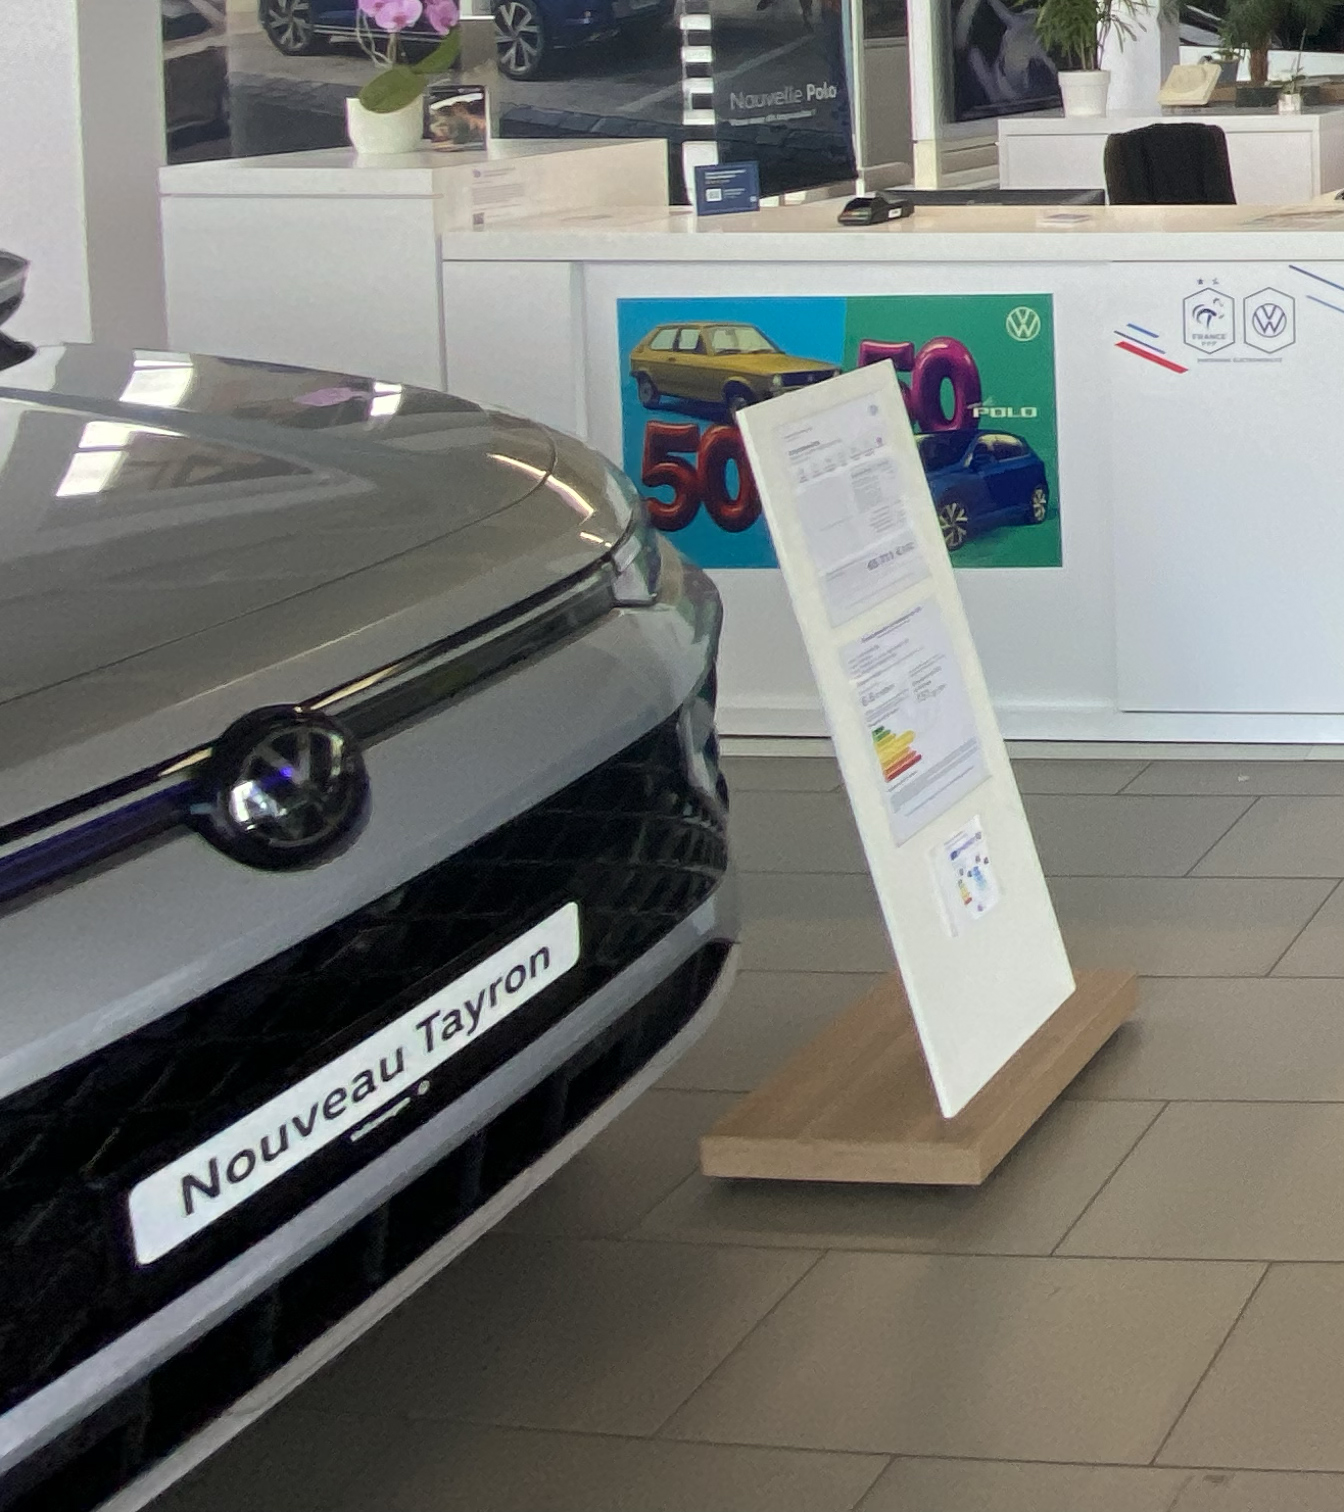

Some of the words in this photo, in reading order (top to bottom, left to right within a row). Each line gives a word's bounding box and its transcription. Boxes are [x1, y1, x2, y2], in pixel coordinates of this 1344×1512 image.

[730, 85, 804, 110] Nouvelle
[806, 82, 838, 102] Polo
[973, 406, 1038, 419] POLO
[641, 420, 763, 533] 50
[179, 1048, 406, 1216] Nouveau
[416, 943, 551, 1056] Tayron
